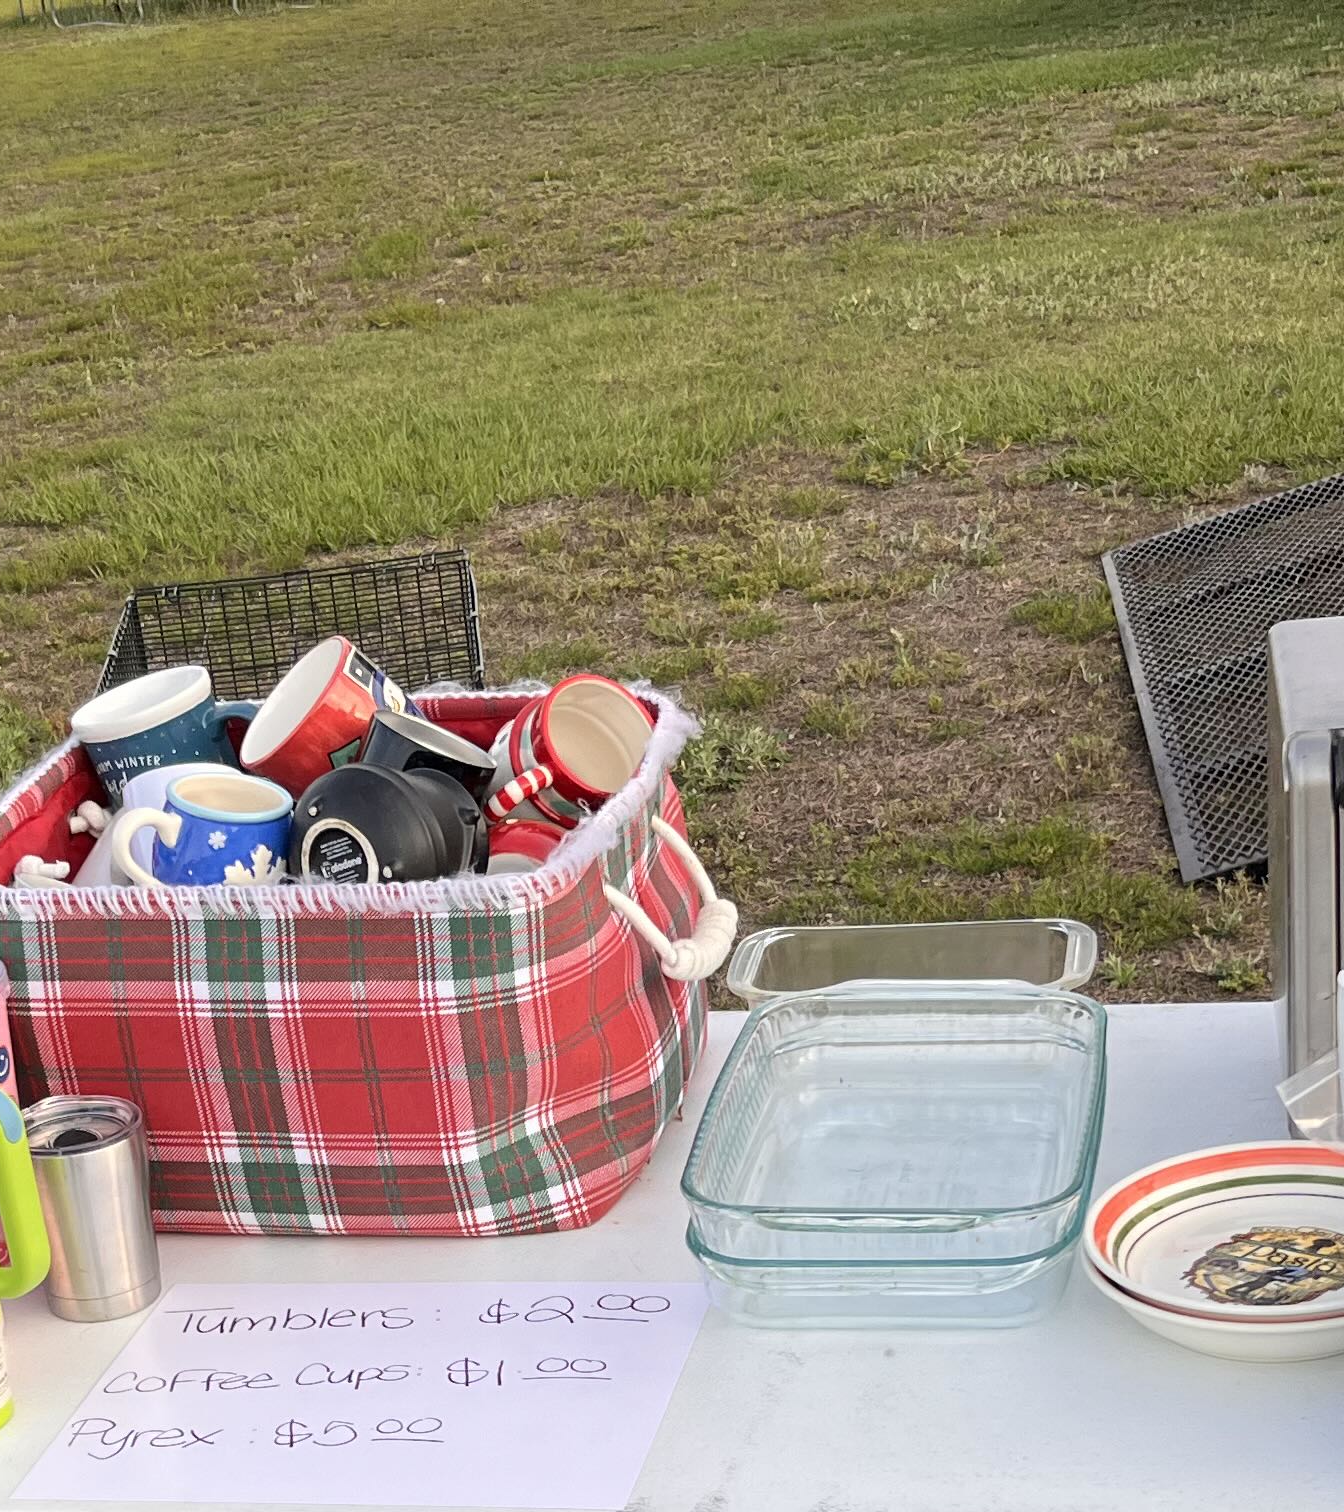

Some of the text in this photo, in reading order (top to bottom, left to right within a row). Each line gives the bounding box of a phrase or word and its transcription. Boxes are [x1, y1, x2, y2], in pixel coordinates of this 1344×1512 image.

[115, 756, 161, 769] WINTER
[478, 1293, 671, 1325] $2.00
[295, 1362, 424, 1391] Cups:
[446, 1356, 611, 1387] $1.00
[273, 1417, 445, 1448] $5.00
